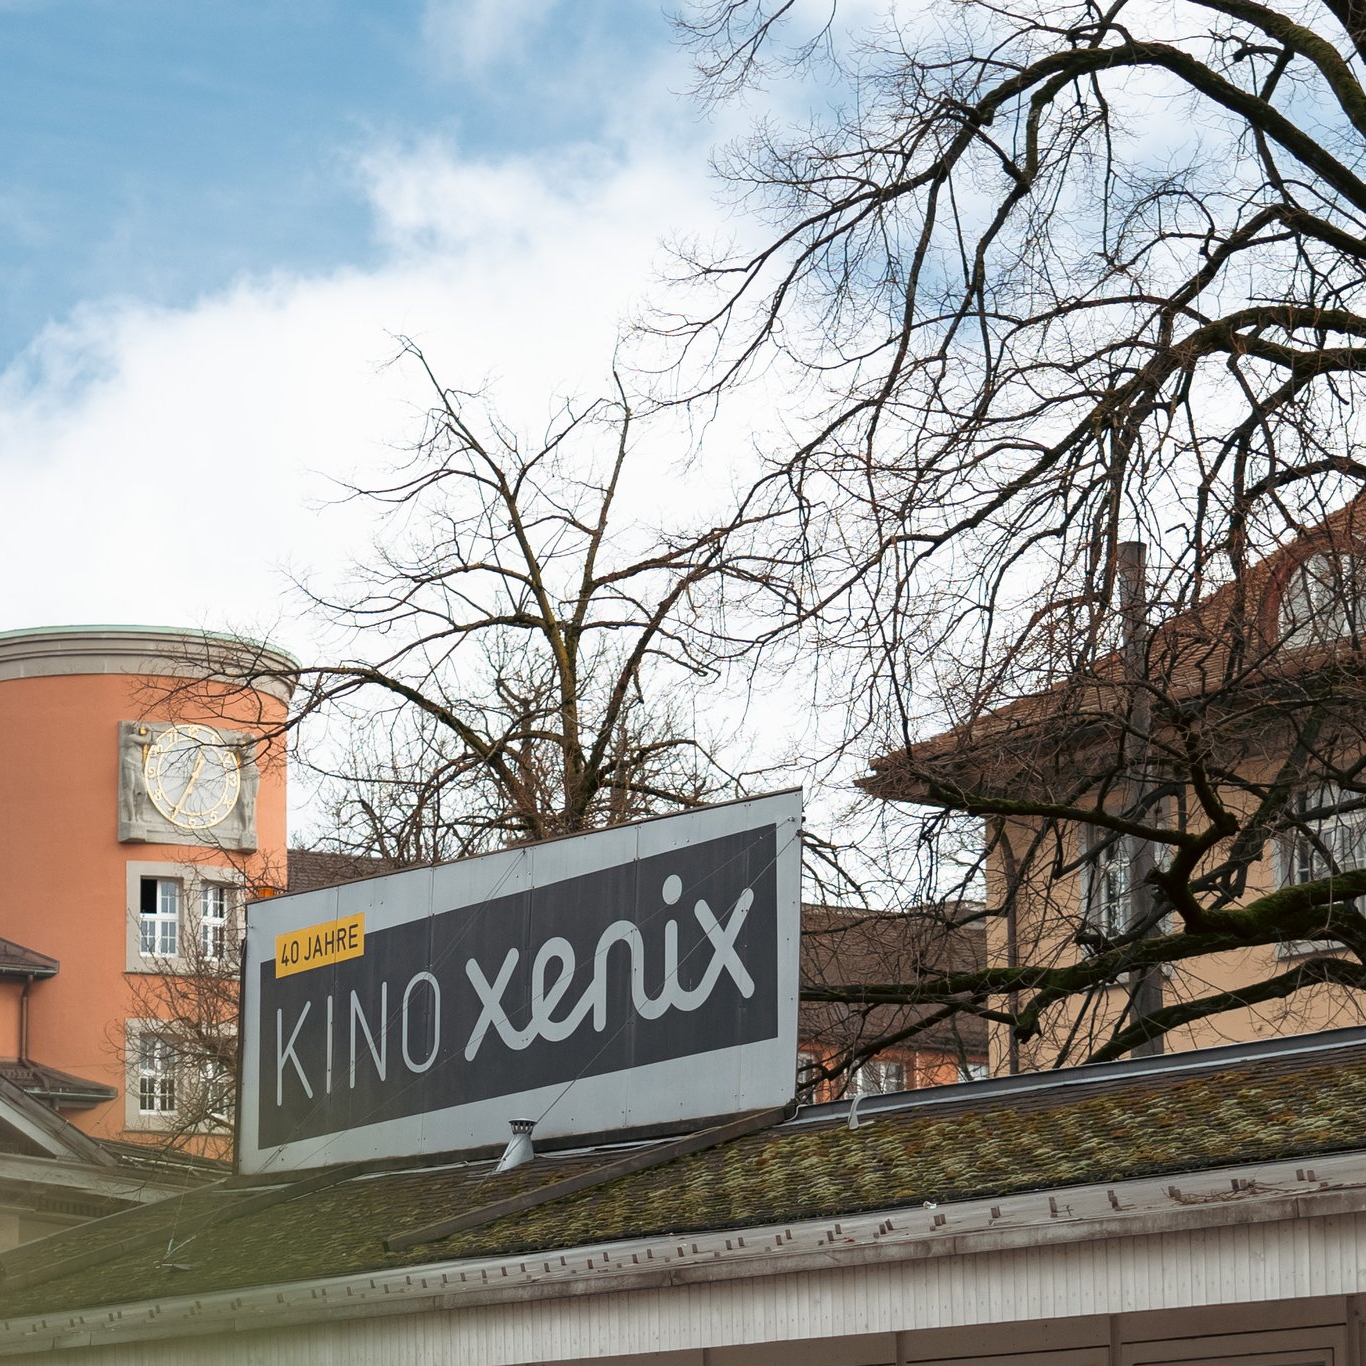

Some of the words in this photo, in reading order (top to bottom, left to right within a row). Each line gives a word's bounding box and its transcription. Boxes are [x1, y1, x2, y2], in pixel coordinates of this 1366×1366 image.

[187, 727, 198, 736] 12
[169, 733, 178, 742] 11
[210, 735, 216, 744] 1
[150, 745, 162, 756] 10
[222, 752, 231, 763] 2
[147, 767, 156, 778] 9
[229, 775, 238, 787] 3
[154, 789, 162, 800] 8
[223, 795, 233, 808] 4
[189, 815, 198, 825] 6
[210, 811, 219, 822] 5
[280, 937, 300, 967] 40
[303, 923, 360, 960] JAHRE
[276, 970, 441, 1107] KINO
[463, 874, 757, 1062] xenix
